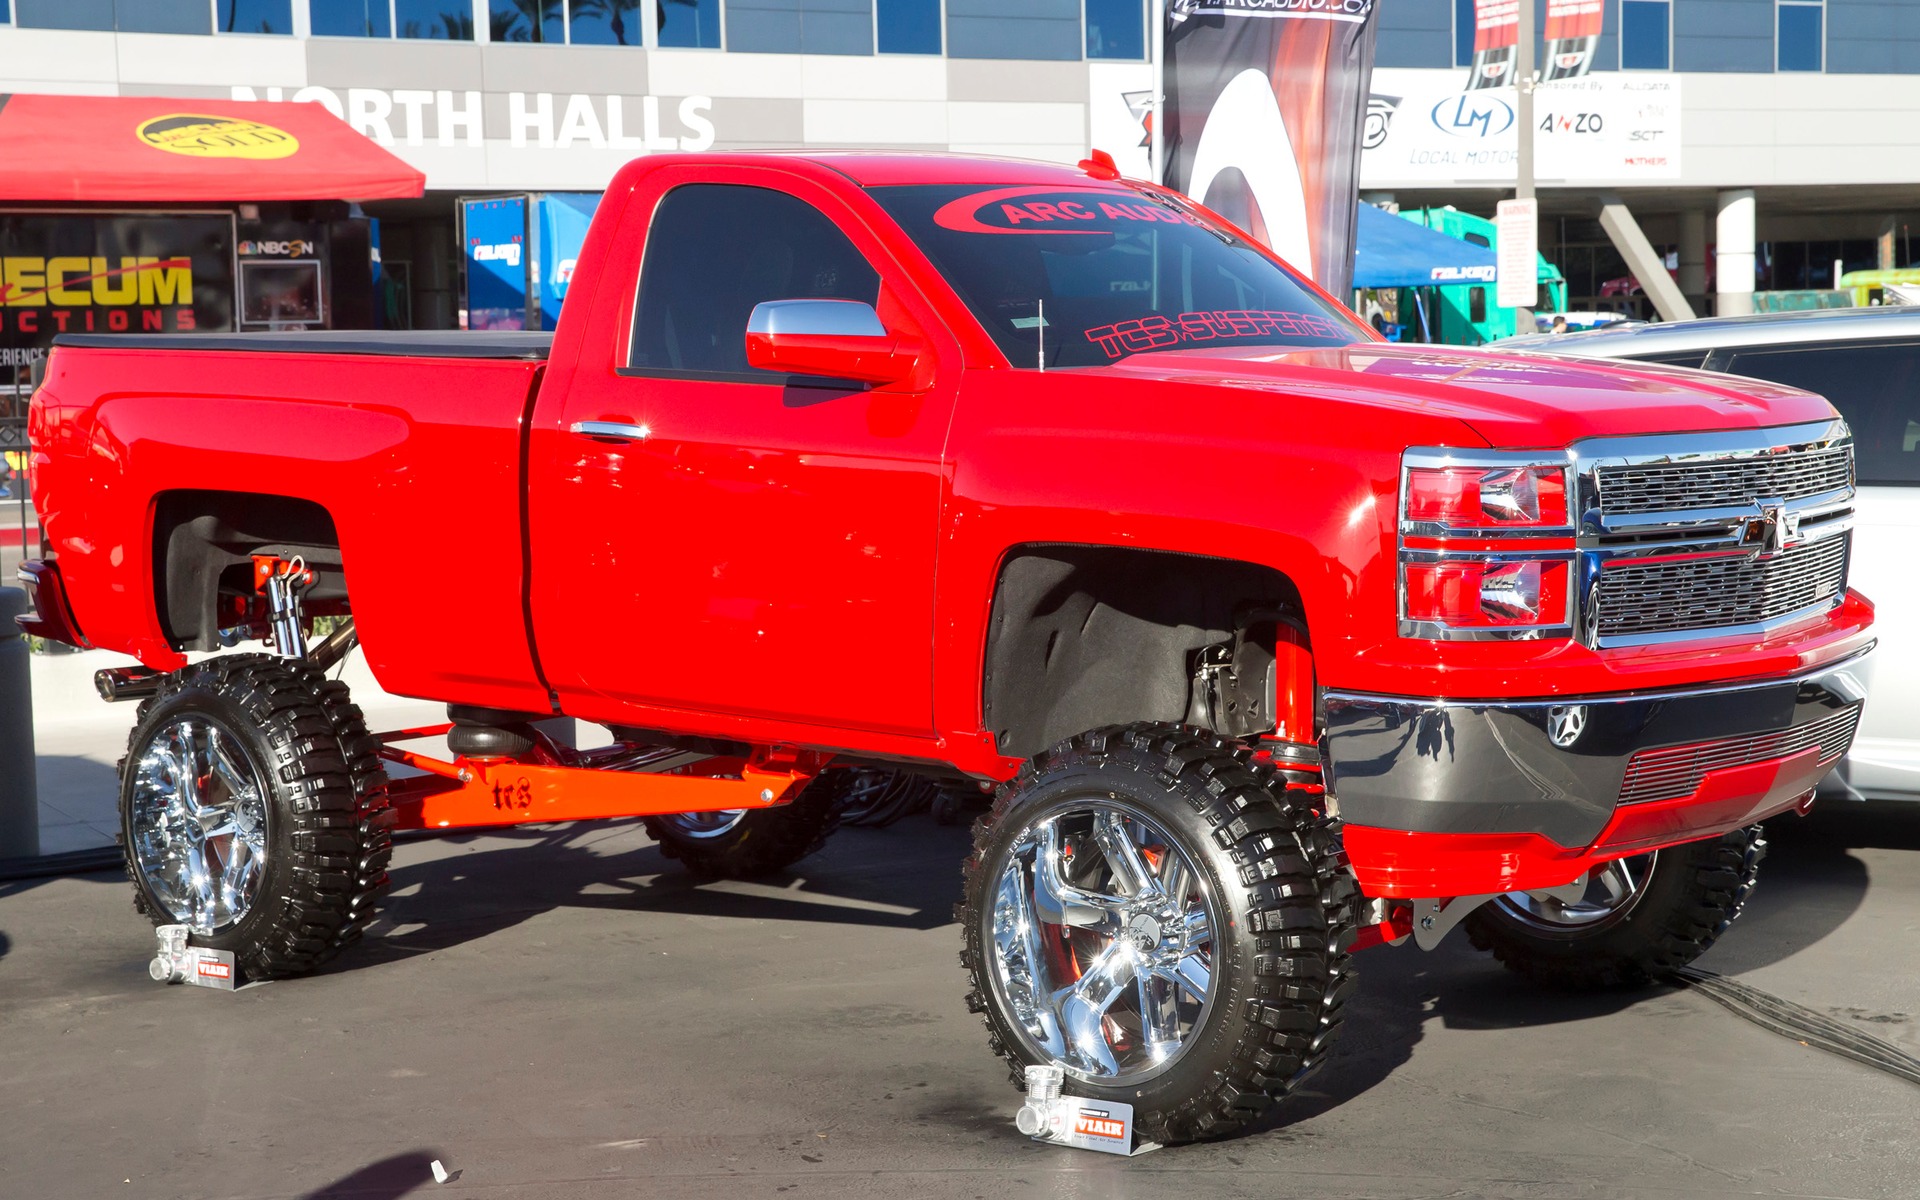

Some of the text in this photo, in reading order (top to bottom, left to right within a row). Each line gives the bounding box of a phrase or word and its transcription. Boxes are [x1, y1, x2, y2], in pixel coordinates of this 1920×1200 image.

[508, 91, 716, 153] HALLS
[1539, 112, 1603, 133] ANZO
[1629, 130, 1664, 141] SCT
[1409, 148, 1458, 164] LOCAL
[1625, 157, 1668, 166] MOTHERS
[1000, 201, 1196, 227] ARC AUDI
[0, 256, 193, 307] ECUM
[1431, 265, 1496, 282] FALKEN
[1084, 316, 1178, 358] TCS
[1077, 1118, 1123, 1136] VIAIR
